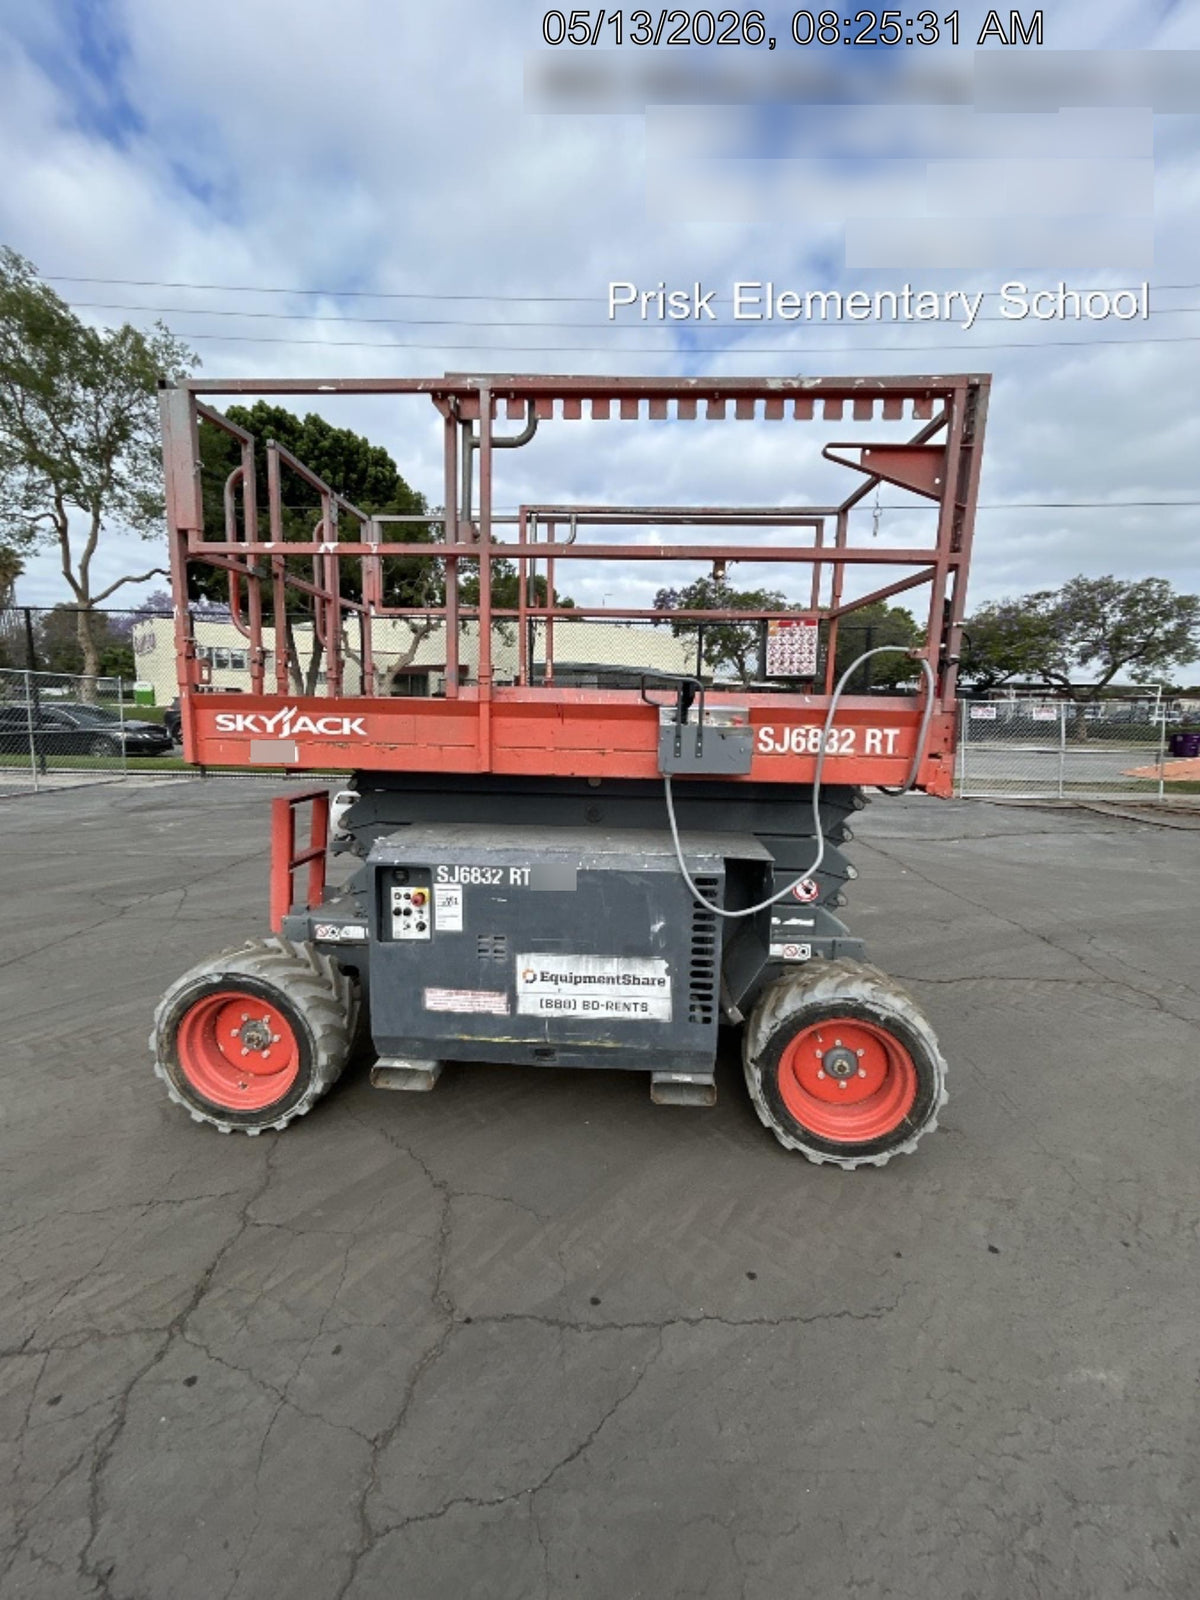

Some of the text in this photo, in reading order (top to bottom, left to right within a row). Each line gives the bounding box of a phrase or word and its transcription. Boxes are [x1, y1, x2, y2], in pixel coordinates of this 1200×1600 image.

[214, 706, 368, 738] SKYJACK
[757, 726, 900, 755] SJ6832 RT
[436, 865, 531, 886] SJ6832 RT
[540, 971, 666, 987] EquipmentShare
